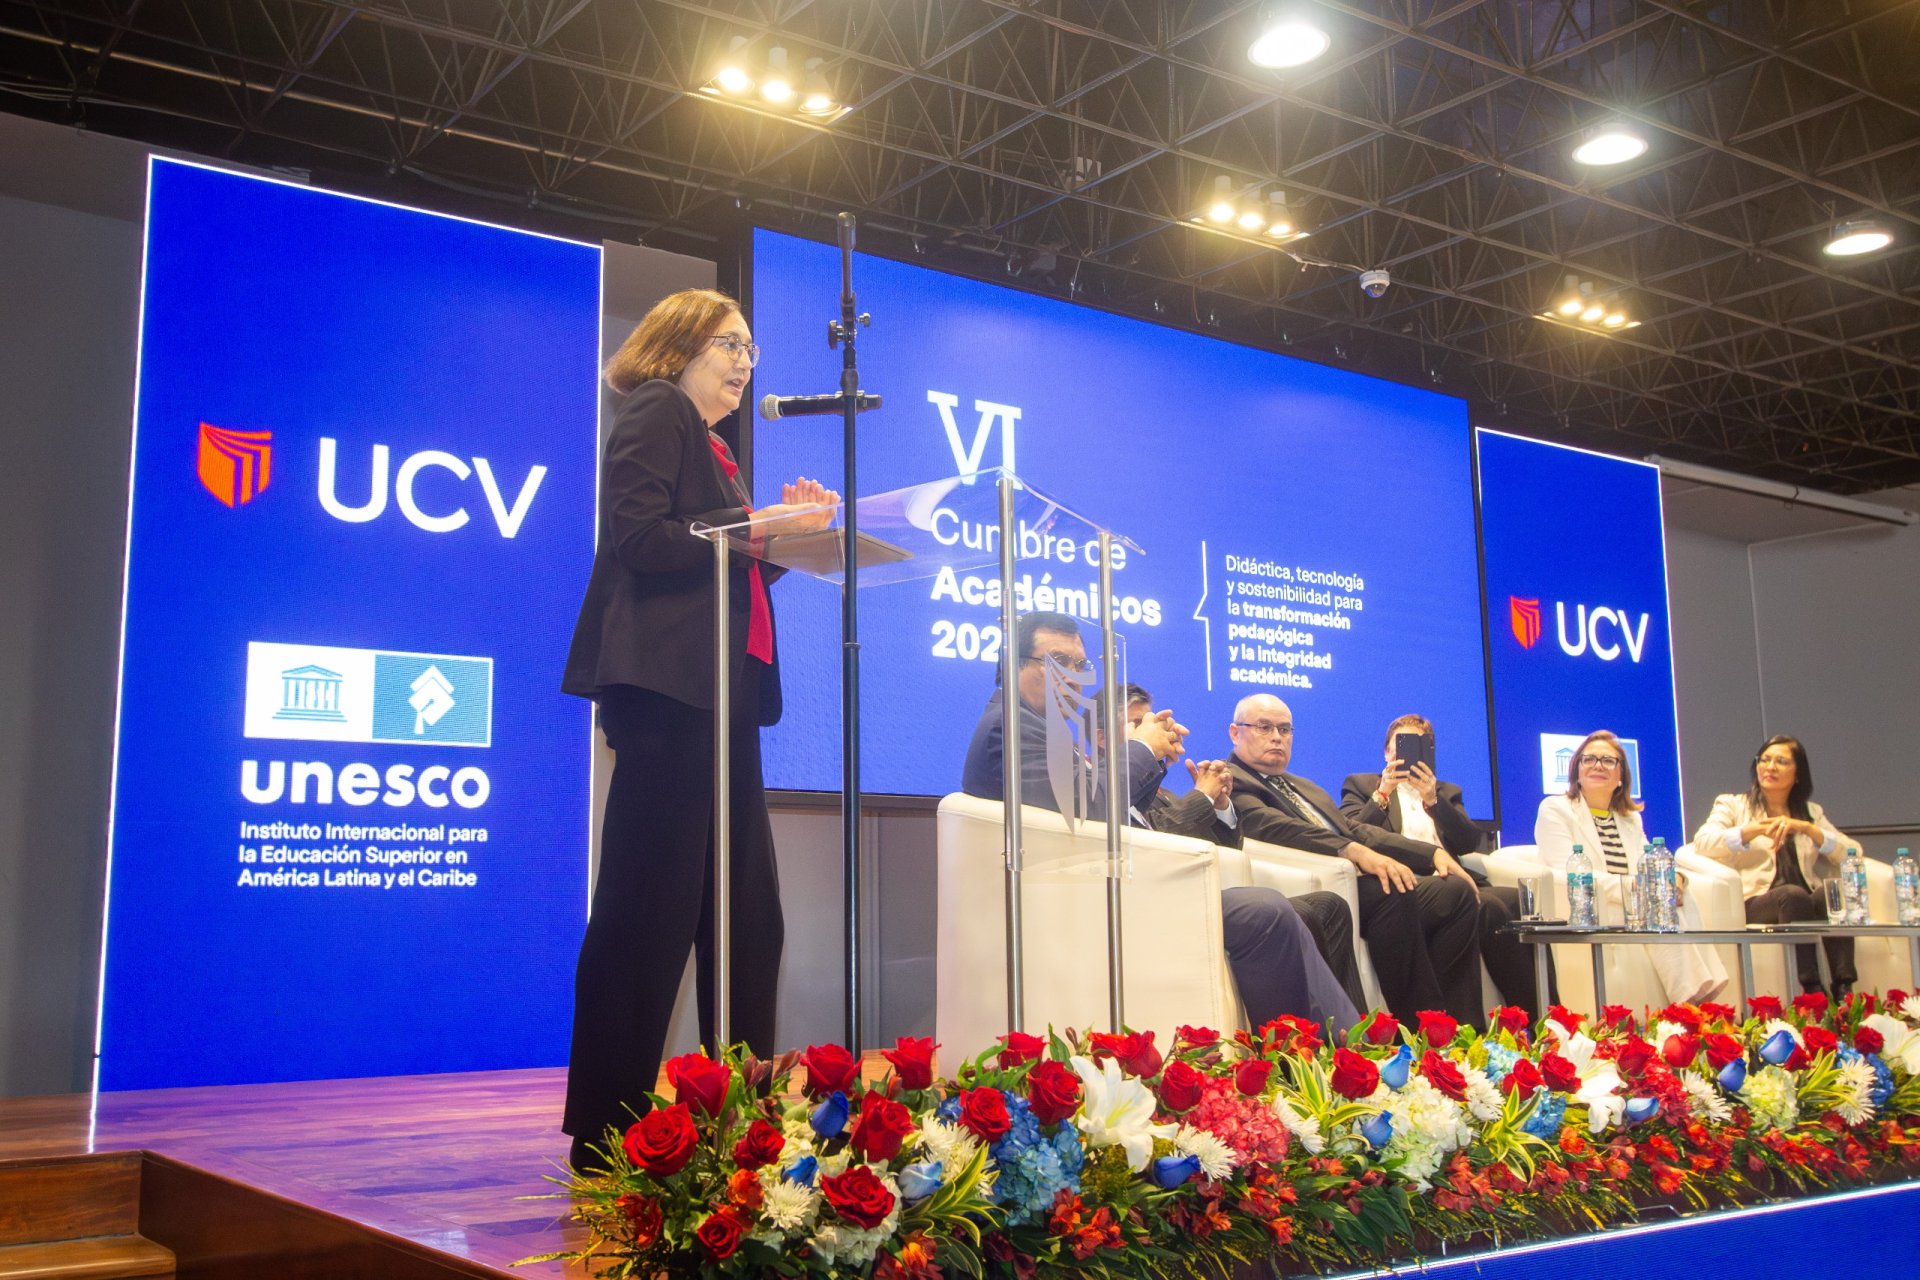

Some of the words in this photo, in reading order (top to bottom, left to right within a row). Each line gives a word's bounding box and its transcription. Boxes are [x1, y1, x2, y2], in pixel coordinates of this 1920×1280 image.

[927, 390, 1023, 490] VI
[318, 438, 547, 538] UCV
[1226, 555, 1294, 582] Didáctica,
[1296, 567, 1364, 592] tecnología
[1227, 580, 1234, 595] y
[1238, 581, 1330, 606] sostenibilidad
[1334, 596, 1362, 610] para
[1228, 598, 1240, 615] la
[1243, 602, 1350, 629] transformación
[932, 620, 1002, 662] 202
[1228, 623, 1314, 647] pedagógica
[1557, 602, 1649, 662] UCV
[1229, 646, 1238, 661] y
[1242, 644, 1255, 660] la
[1258, 645, 1331, 669] integridad
[1230, 667, 1312, 688] académica.
[241, 760, 490, 808] unesco
[241, 821, 321, 840] Instituto
[326, 823, 444, 841] Internacional
[448, 828, 487, 845] para
[239, 845, 257, 863] la
[261, 844, 361, 863] Educación
[366, 846, 442, 867] Superior
[445, 851, 467, 864] en
[238, 867, 319, 886] América
[324, 869, 381, 886] Latina
[384, 873, 395, 889] y
[398, 869, 414, 886] el
[418, 869, 477, 886] Caribe
